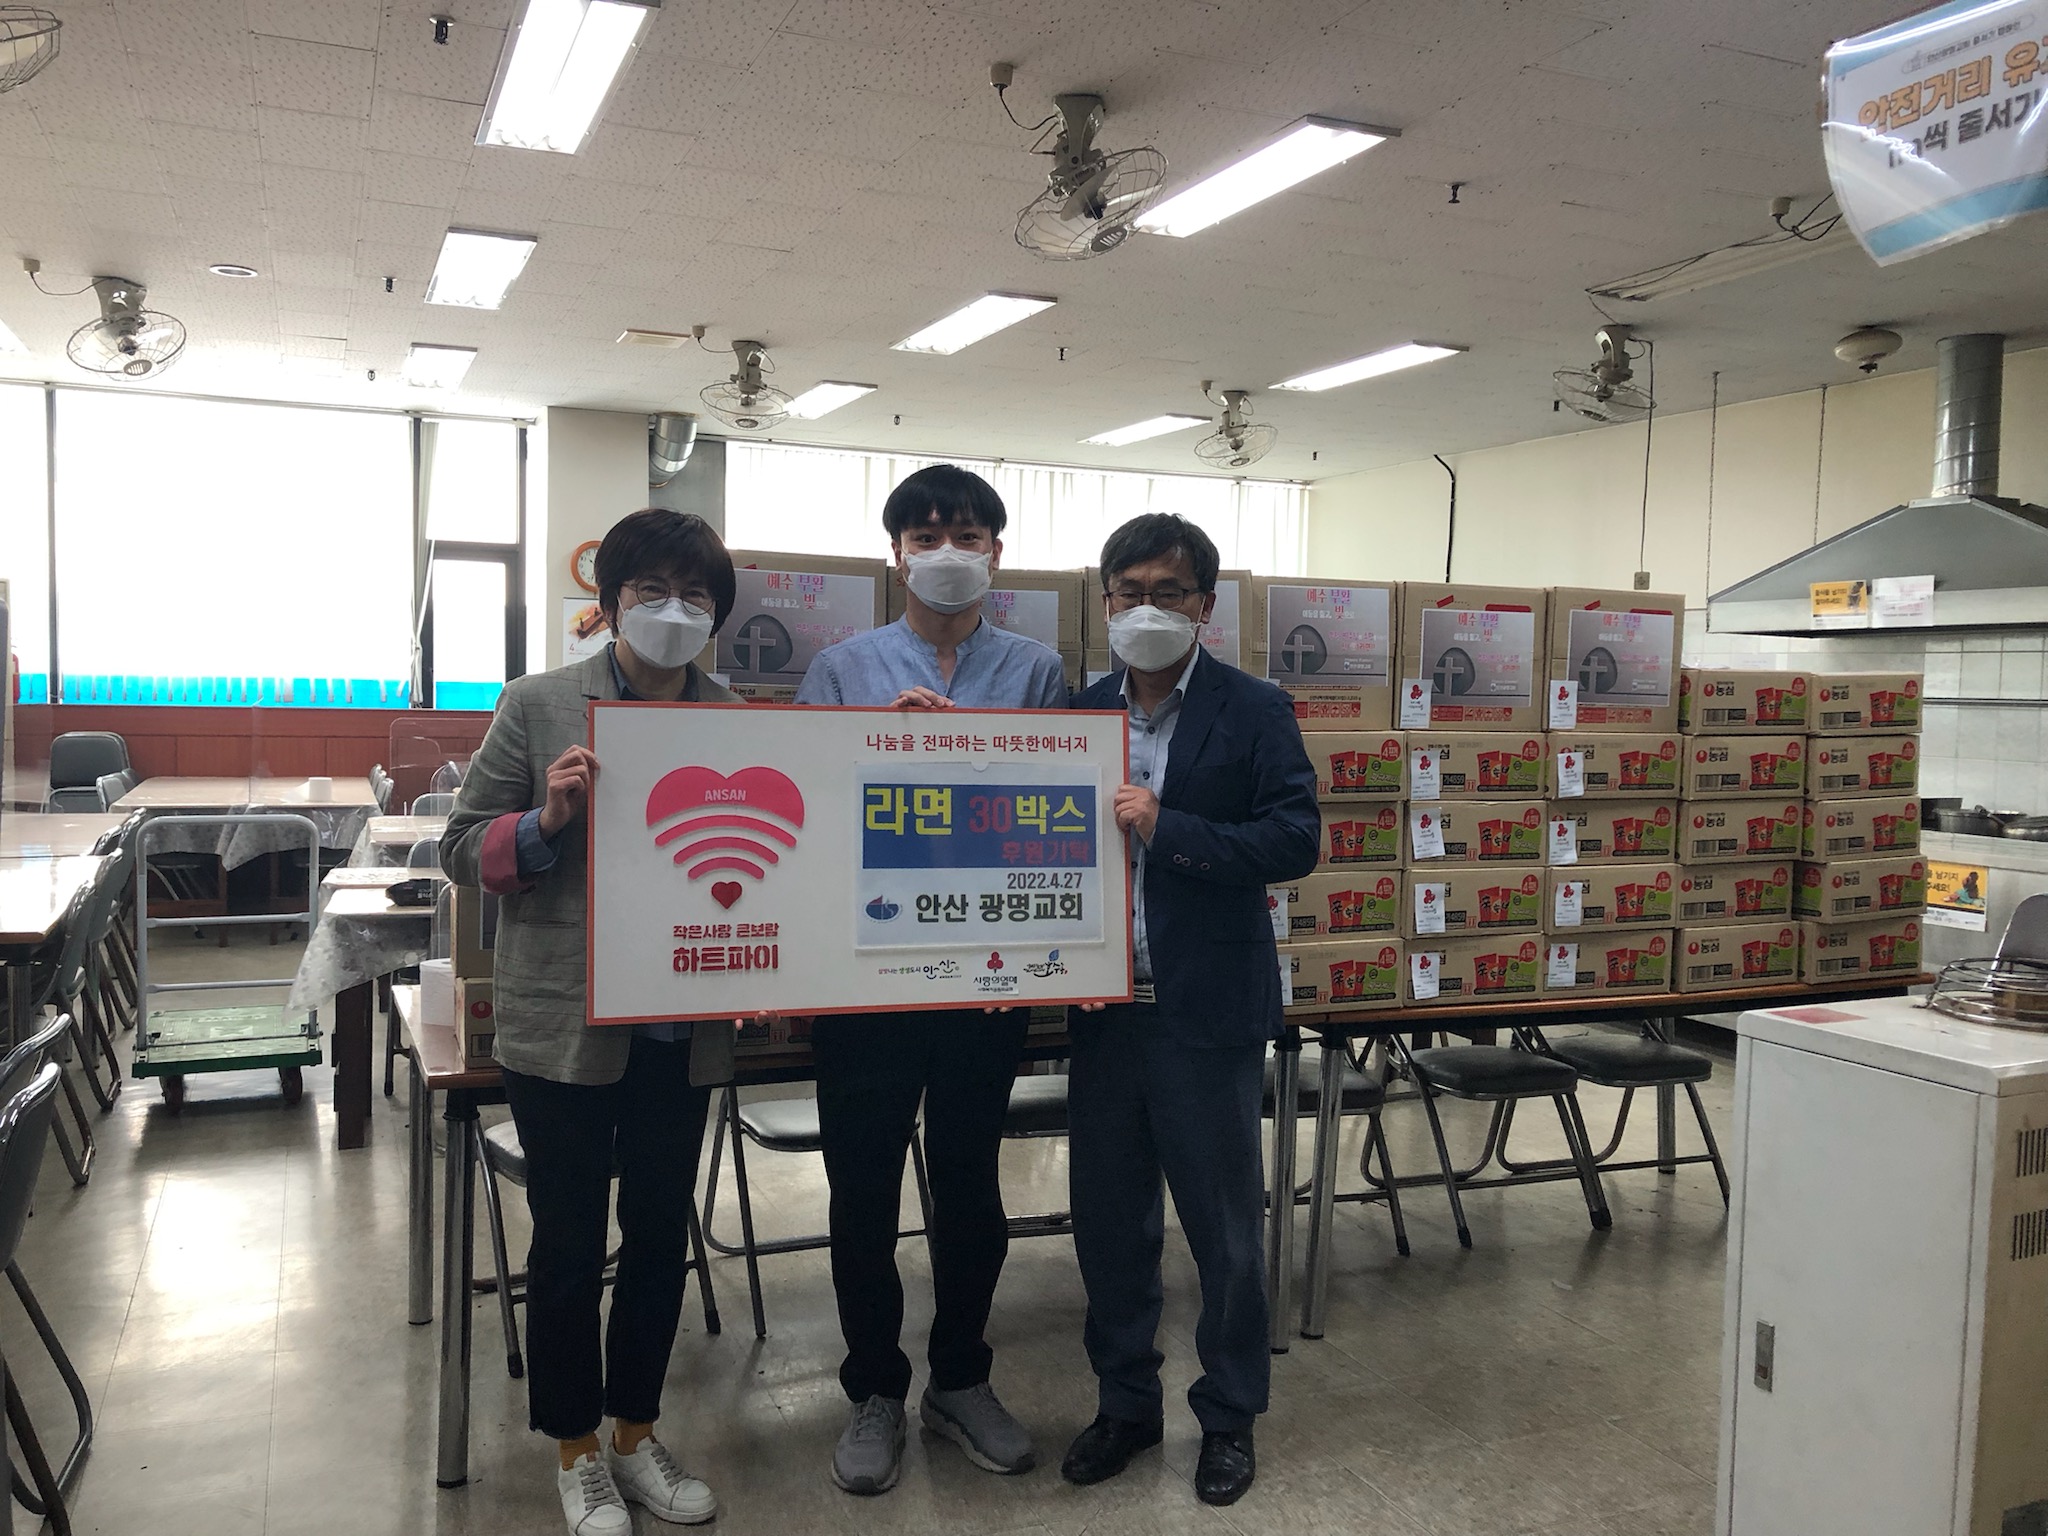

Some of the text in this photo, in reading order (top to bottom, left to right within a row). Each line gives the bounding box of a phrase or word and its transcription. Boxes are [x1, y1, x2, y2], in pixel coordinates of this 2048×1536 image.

[1858, 55, 1992, 134] 안전거리
[1958, 88, 2043, 144] 줄서기
[767, 573, 794, 590] 예수
[1716, 686, 1735, 697] 농심
[866, 733, 1088, 752] 나눔을 전파하는 따뜻한에너지
[1440, 749, 1450, 760] 심
[1708, 751, 1728, 762] 농심
[705, 789, 746, 801] ANSAN
[866, 788, 952, 835] 라면
[1440, 819, 1451, 829] 심
[1706, 817, 1725, 828] 농심
[1002, 840, 1090, 865] 후원기탁
[1007, 873, 1083, 889] 2022.4.27
[1694, 880, 1713, 890] 농심
[1288, 892, 1299, 902] 심
[915, 893, 1083, 922] 안산 광명교회
[673, 922, 779, 939] 작은사랑 큰보람
[1700, 943, 1719, 954] 농심
[673, 944, 779, 972] 하트파이
[1291, 962, 1299, 973] 심
[973, 976, 1017, 987] 사랑의열매
